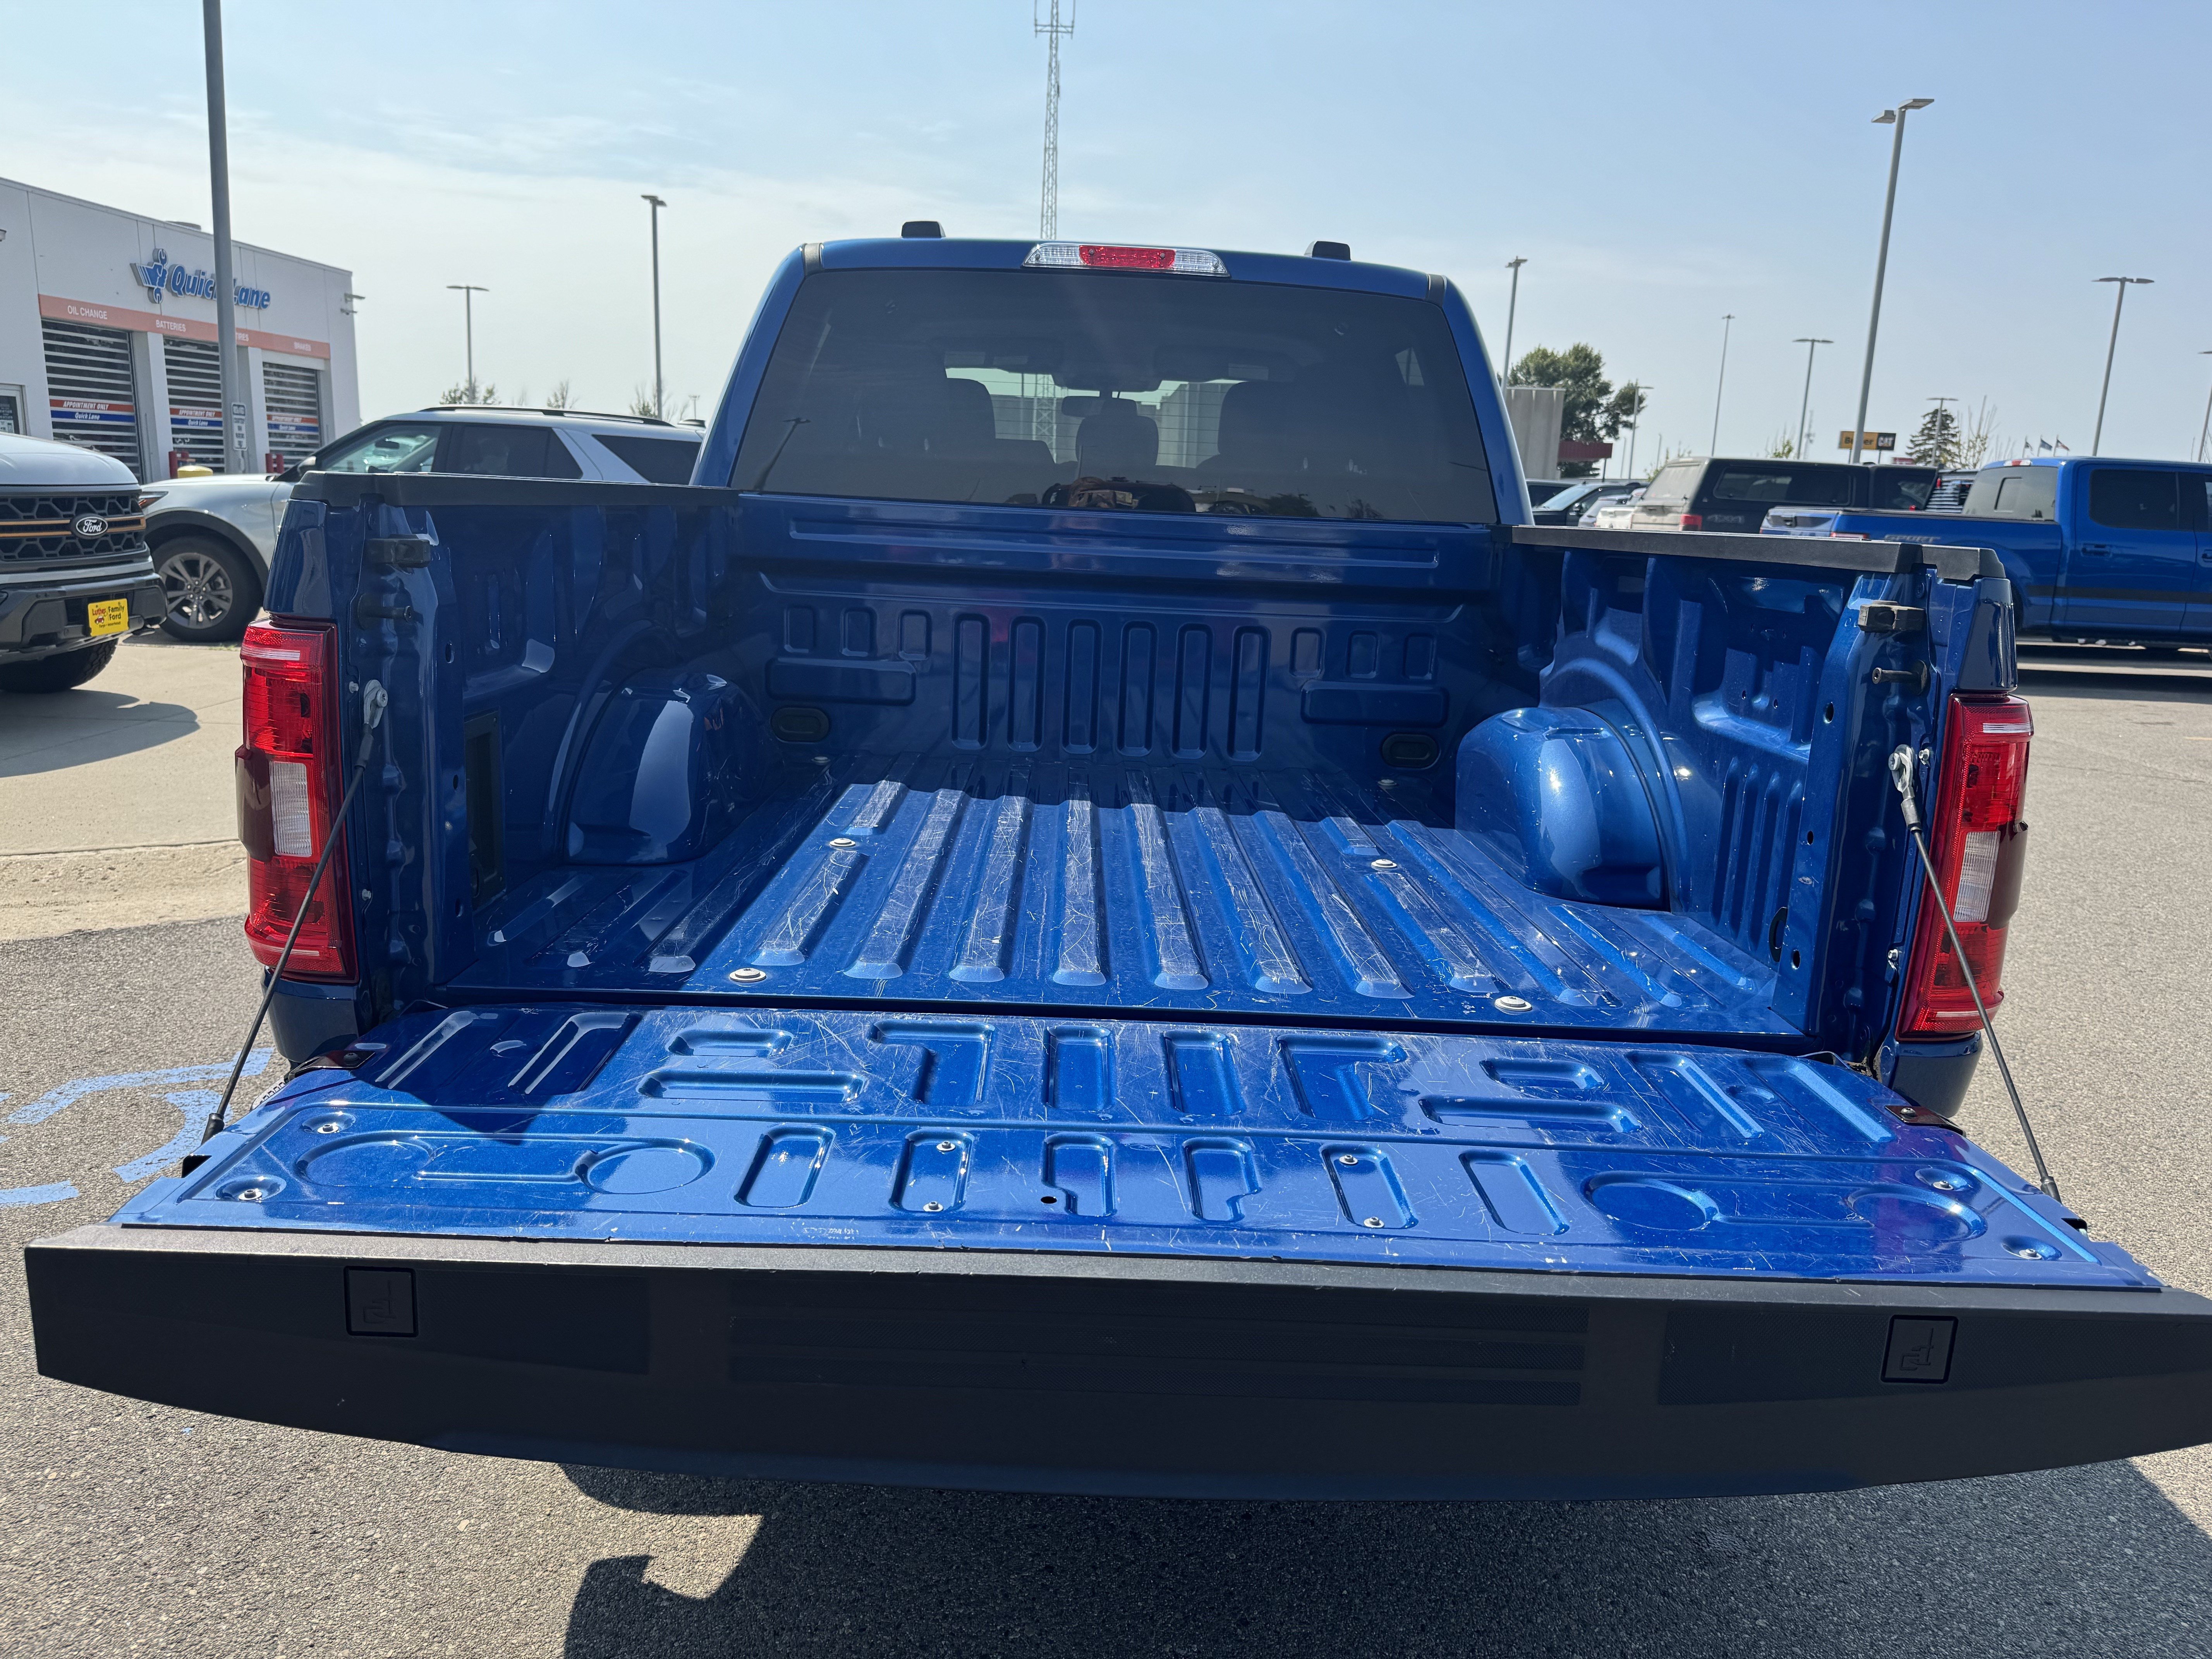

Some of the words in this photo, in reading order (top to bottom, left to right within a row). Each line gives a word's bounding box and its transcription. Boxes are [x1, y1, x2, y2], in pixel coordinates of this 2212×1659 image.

[171, 264, 217, 301] Quic
[233, 278, 271, 310] ane
[67, 305, 79, 316] OIL
[80, 307, 108, 320] CHANGE
[156, 319, 186, 332] BATTERIES
[63, 400, 96, 410] APPOINTMENT
[75, 412, 88, 420] Quick
[1878, 436, 1894, 447] CAT
[82, 519, 103, 533] Ford
[108, 605, 125, 613] Family
[109, 612, 122, 621] Ford
